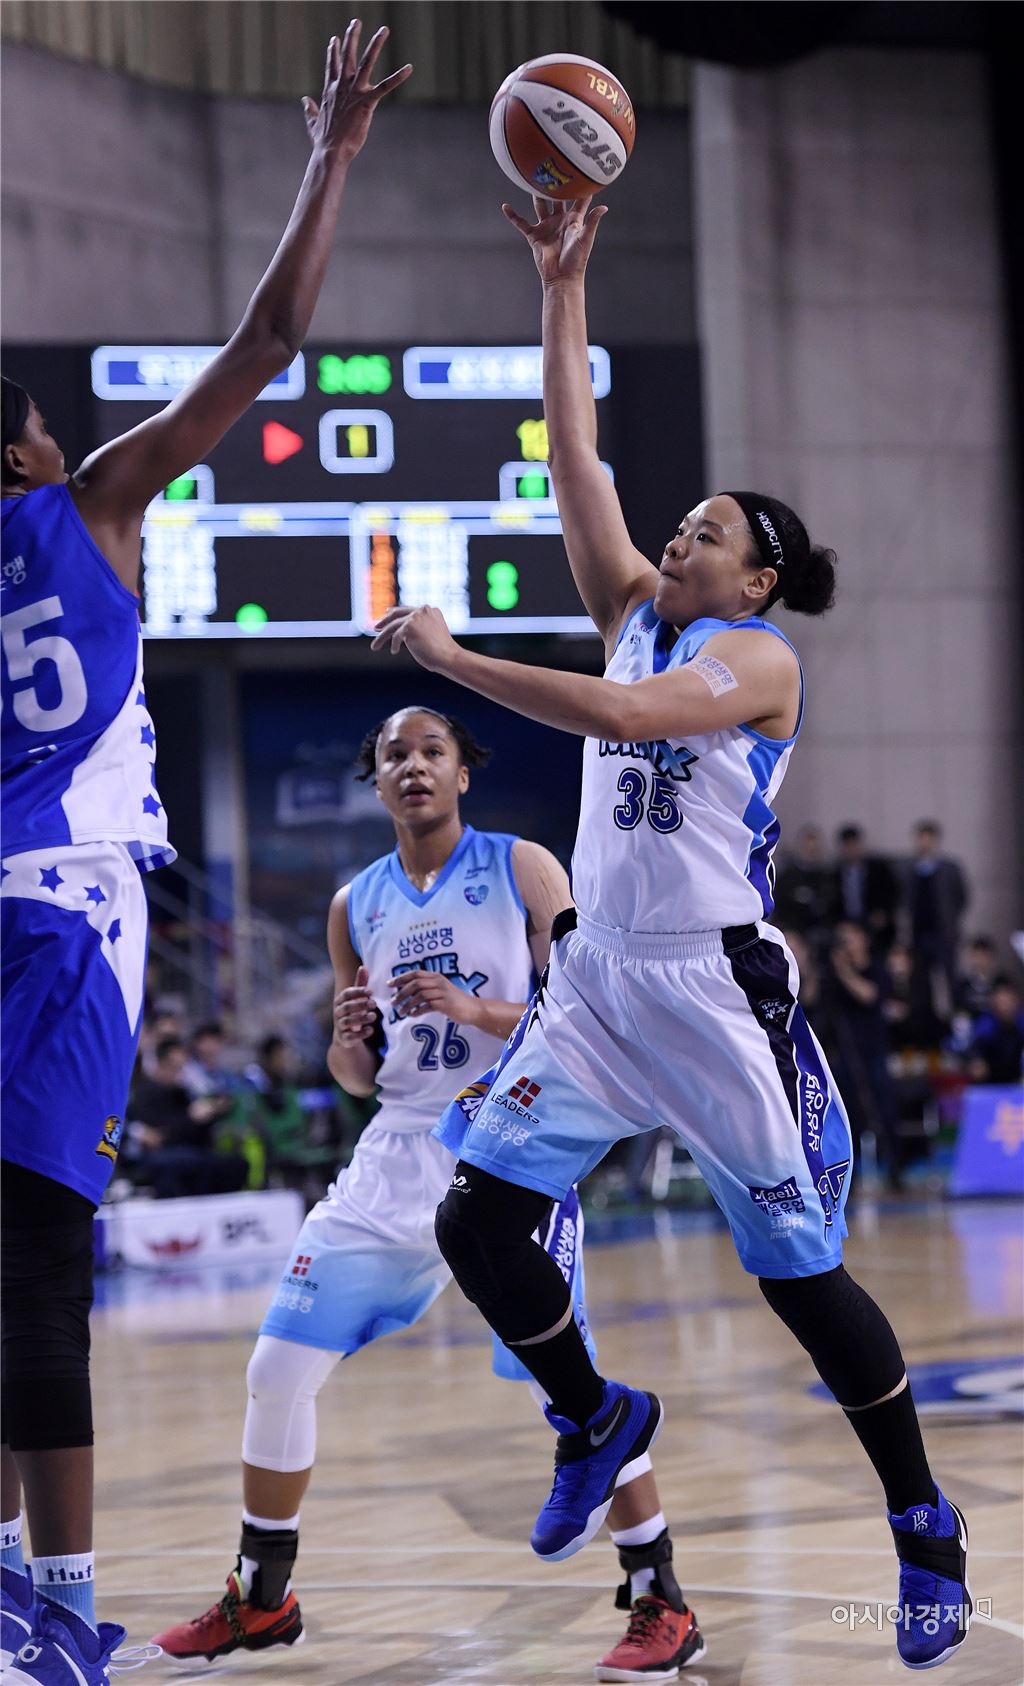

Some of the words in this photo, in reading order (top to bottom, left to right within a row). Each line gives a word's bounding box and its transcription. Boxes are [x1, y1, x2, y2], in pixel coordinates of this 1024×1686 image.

[756, 511, 785, 565] HOOPCITY
[0, 595, 88, 732] 5
[613, 767, 684, 835] 35
[397, 927, 454, 959] 삼성생명
[411, 1019, 471, 1071] 26
[477, 1109, 532, 1147] 삼성생명
[490, 1092, 540, 1124] LEADERS
[755, 1183, 798, 1202] Maeil
